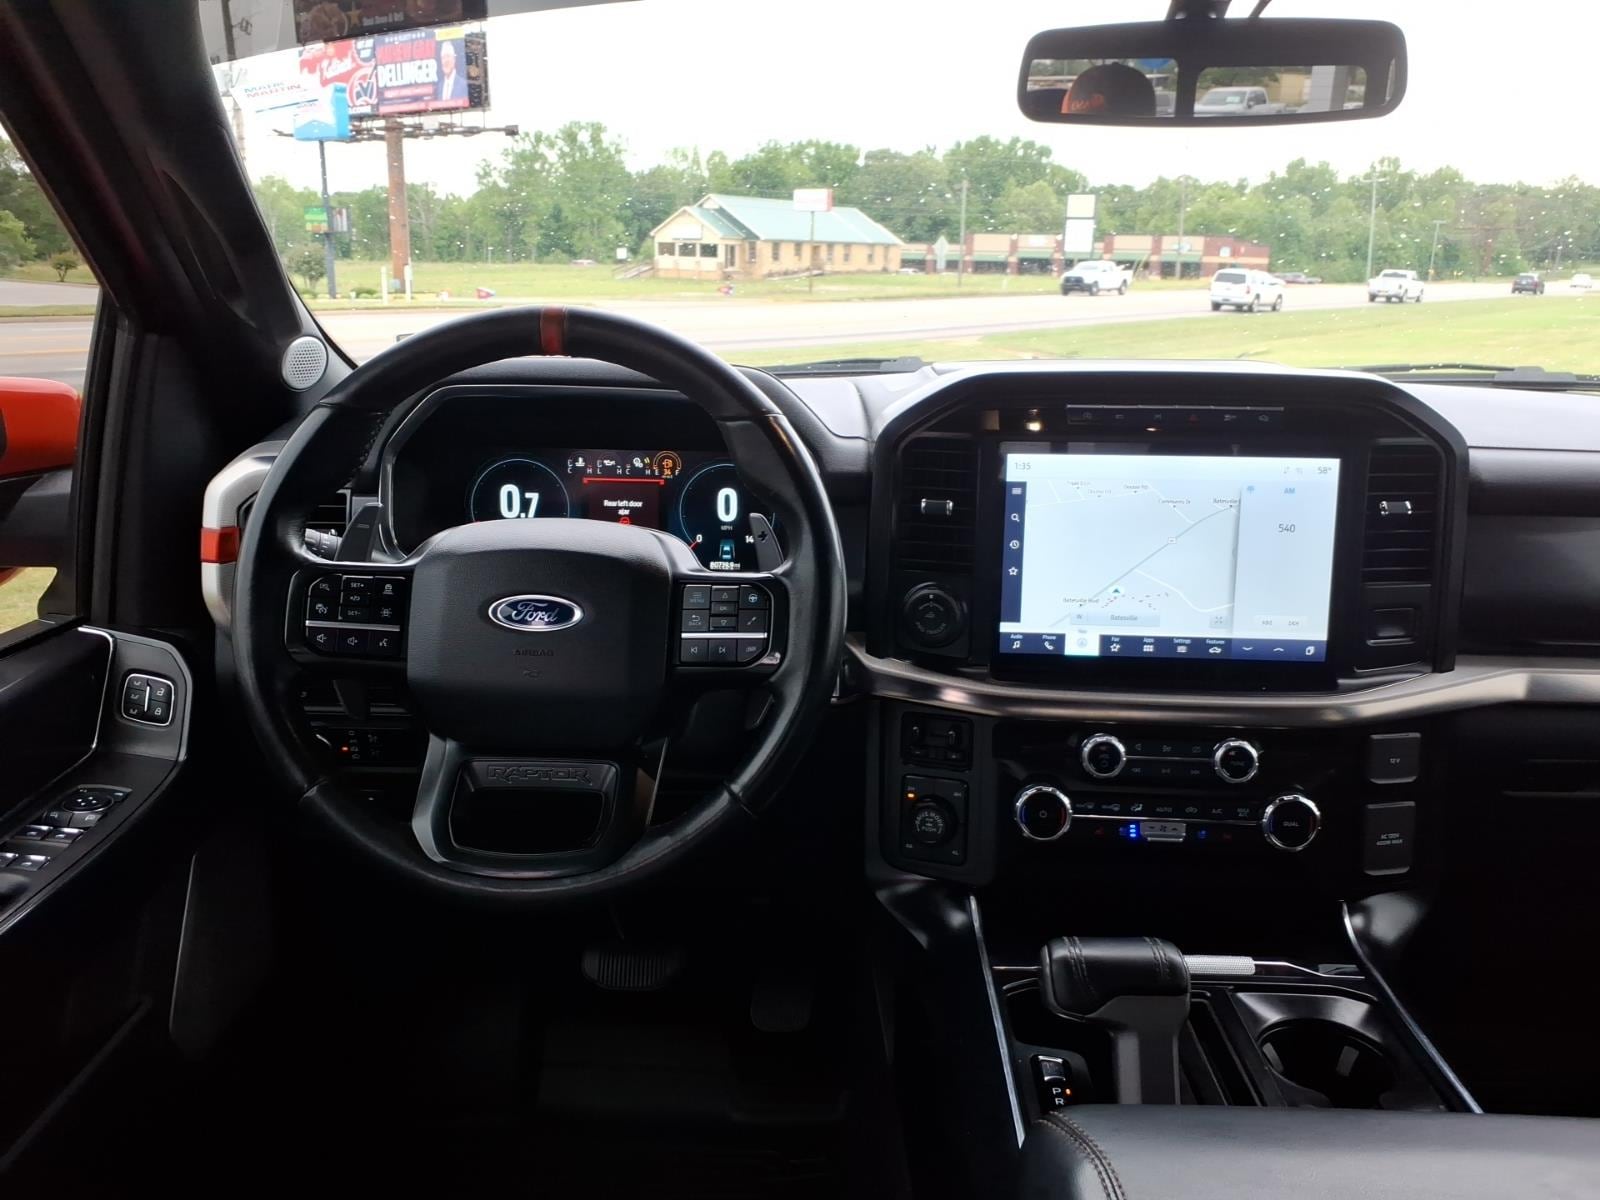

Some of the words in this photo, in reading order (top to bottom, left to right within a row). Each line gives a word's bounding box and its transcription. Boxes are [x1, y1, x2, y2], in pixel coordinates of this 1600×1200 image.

[377, 58, 438, 88] DELLINGER
[1014, 461, 1032, 471] 1:35
[1284, 487, 1296, 495] AM
[500, 484, 539, 518] 0.7
[603, 499, 617, 507] Rear
[618, 499, 628, 507] left
[629, 499, 643, 507] door
[717, 487, 738, 522] 0
[1278, 523, 1296, 533] 540
[696, 534, 703, 543] 0
[511, 601, 560, 622] Ford
[487, 765, 593, 786] RAPTOR
[1052, 1087, 1061, 1095] P
[1055, 1097, 1065, 1106] R
